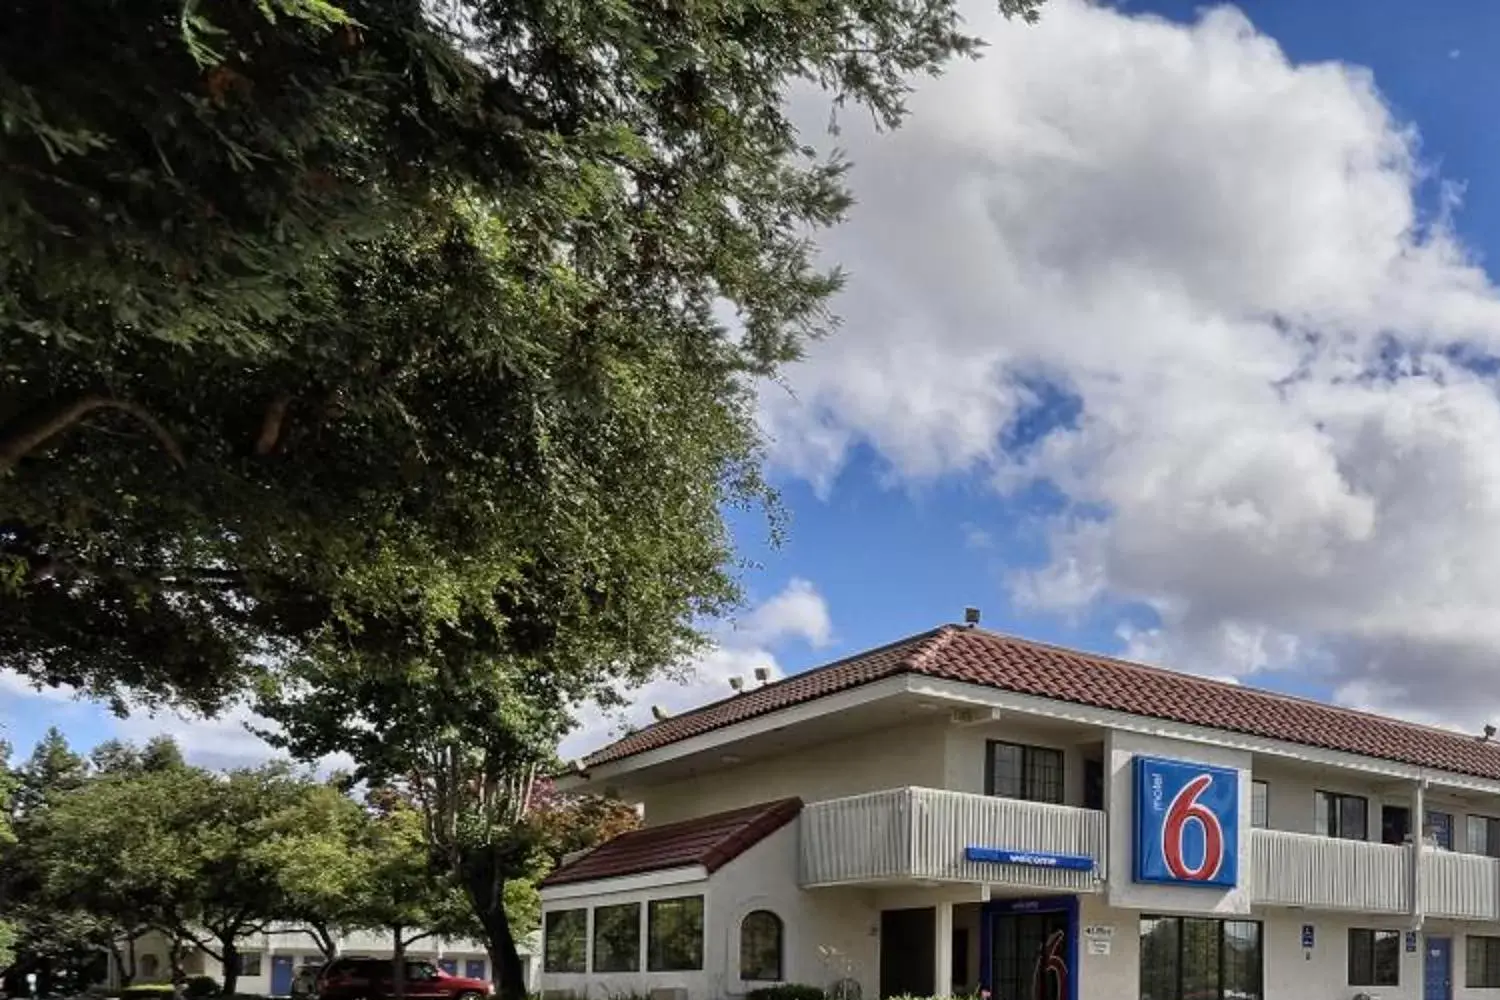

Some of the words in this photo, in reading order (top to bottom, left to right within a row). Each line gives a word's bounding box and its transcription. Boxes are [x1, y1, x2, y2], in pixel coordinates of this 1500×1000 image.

[1152, 773, 1163, 811] motel
[1161, 773, 1224, 881] 6
[1009, 854, 1057, 866] welcome
